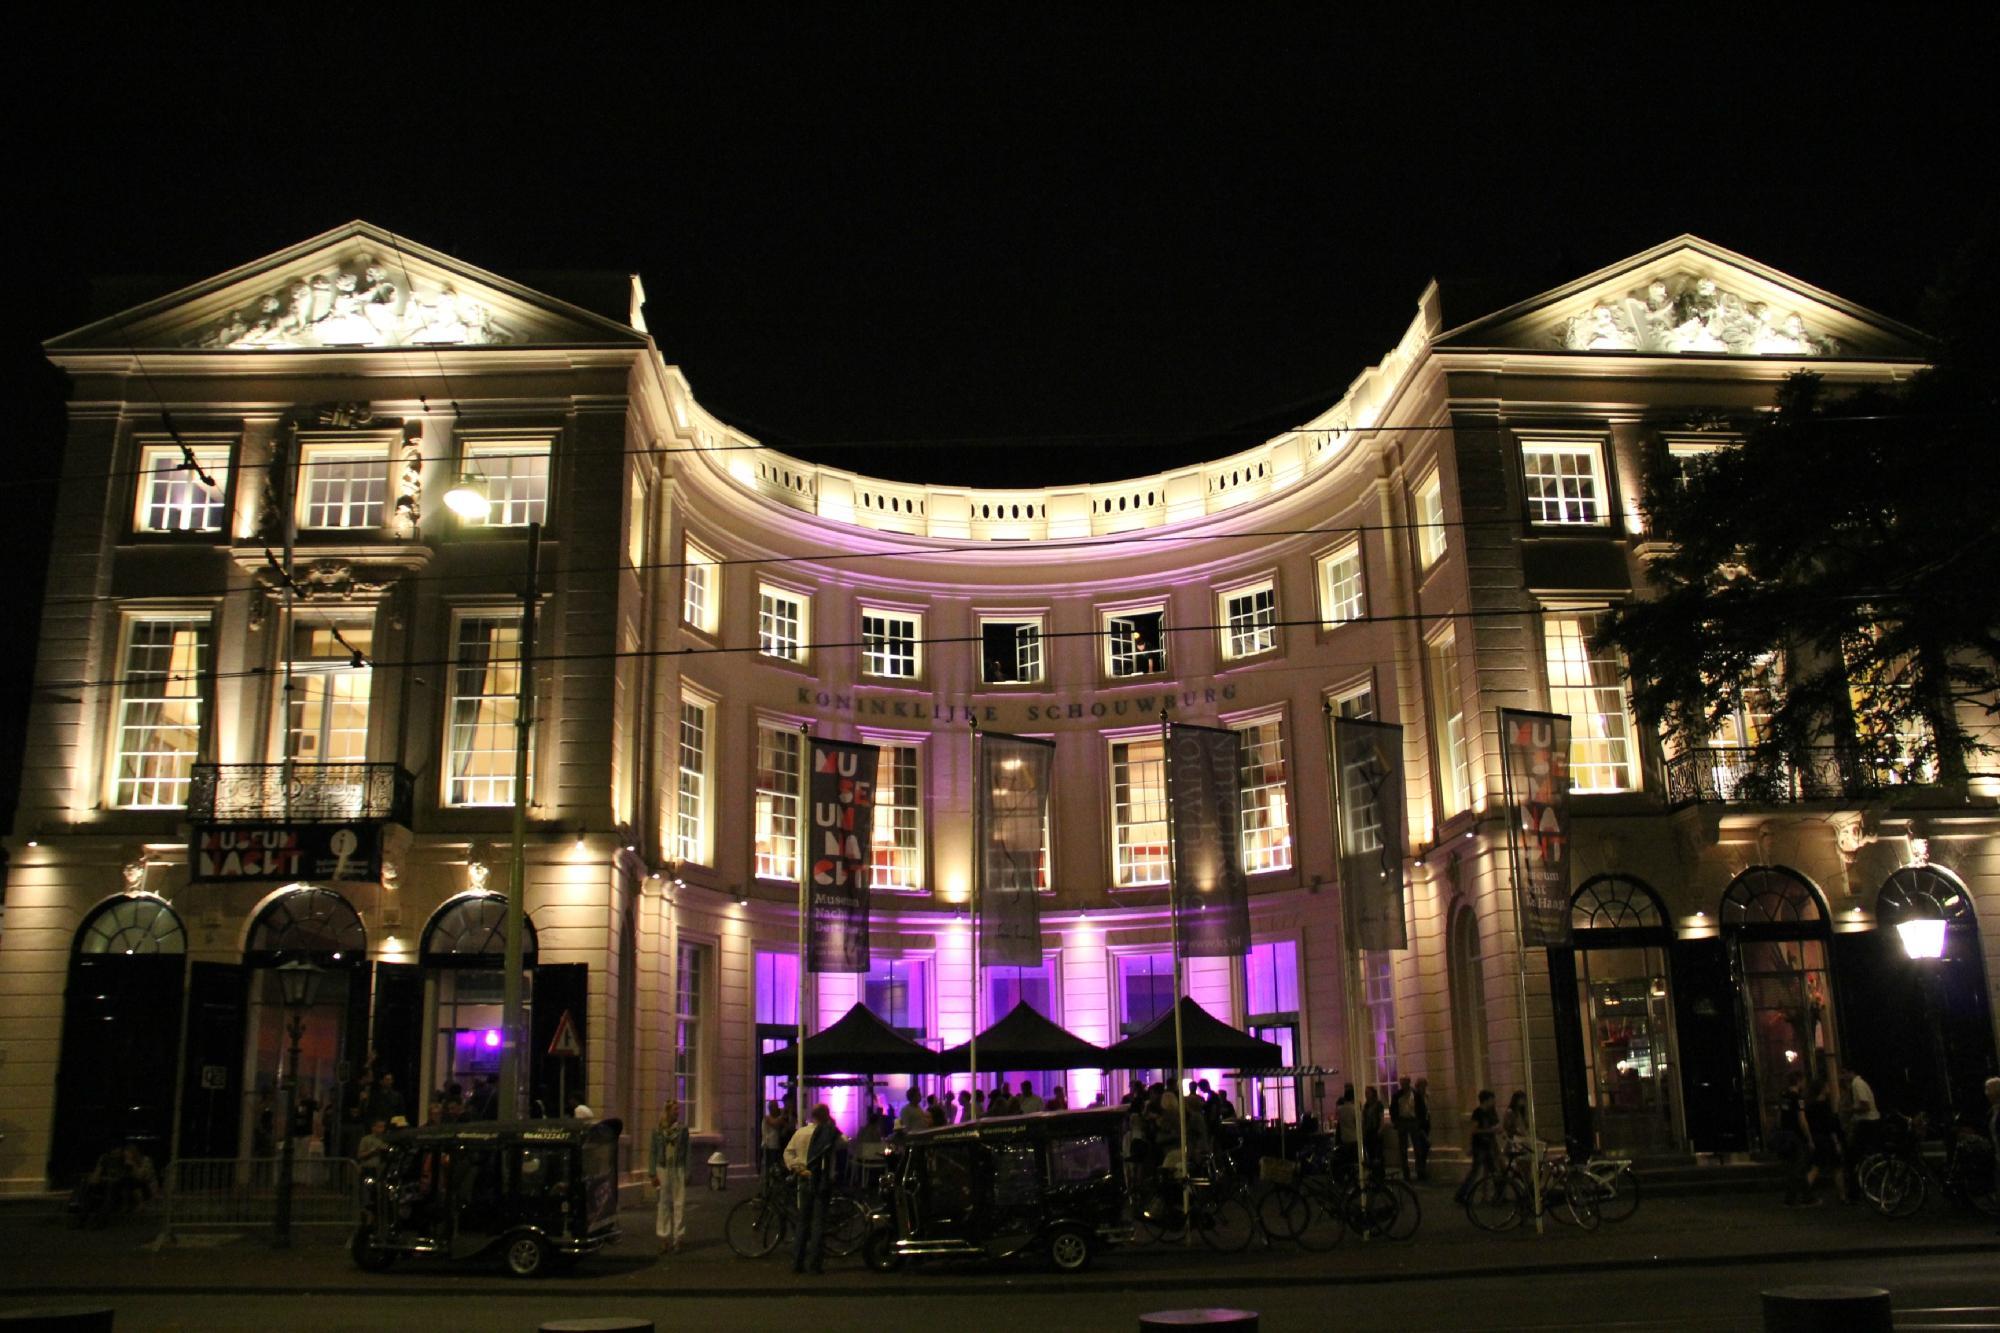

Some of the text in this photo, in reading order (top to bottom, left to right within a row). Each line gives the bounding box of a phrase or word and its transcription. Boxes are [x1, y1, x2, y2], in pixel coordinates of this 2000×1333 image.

[797, 683, 1237, 723] KONINKLIJKE SCHOUWBURG
[815, 748, 858, 777] MU
[201, 831, 298, 849] MUSEUM
[201, 850, 302, 876] NACHT
